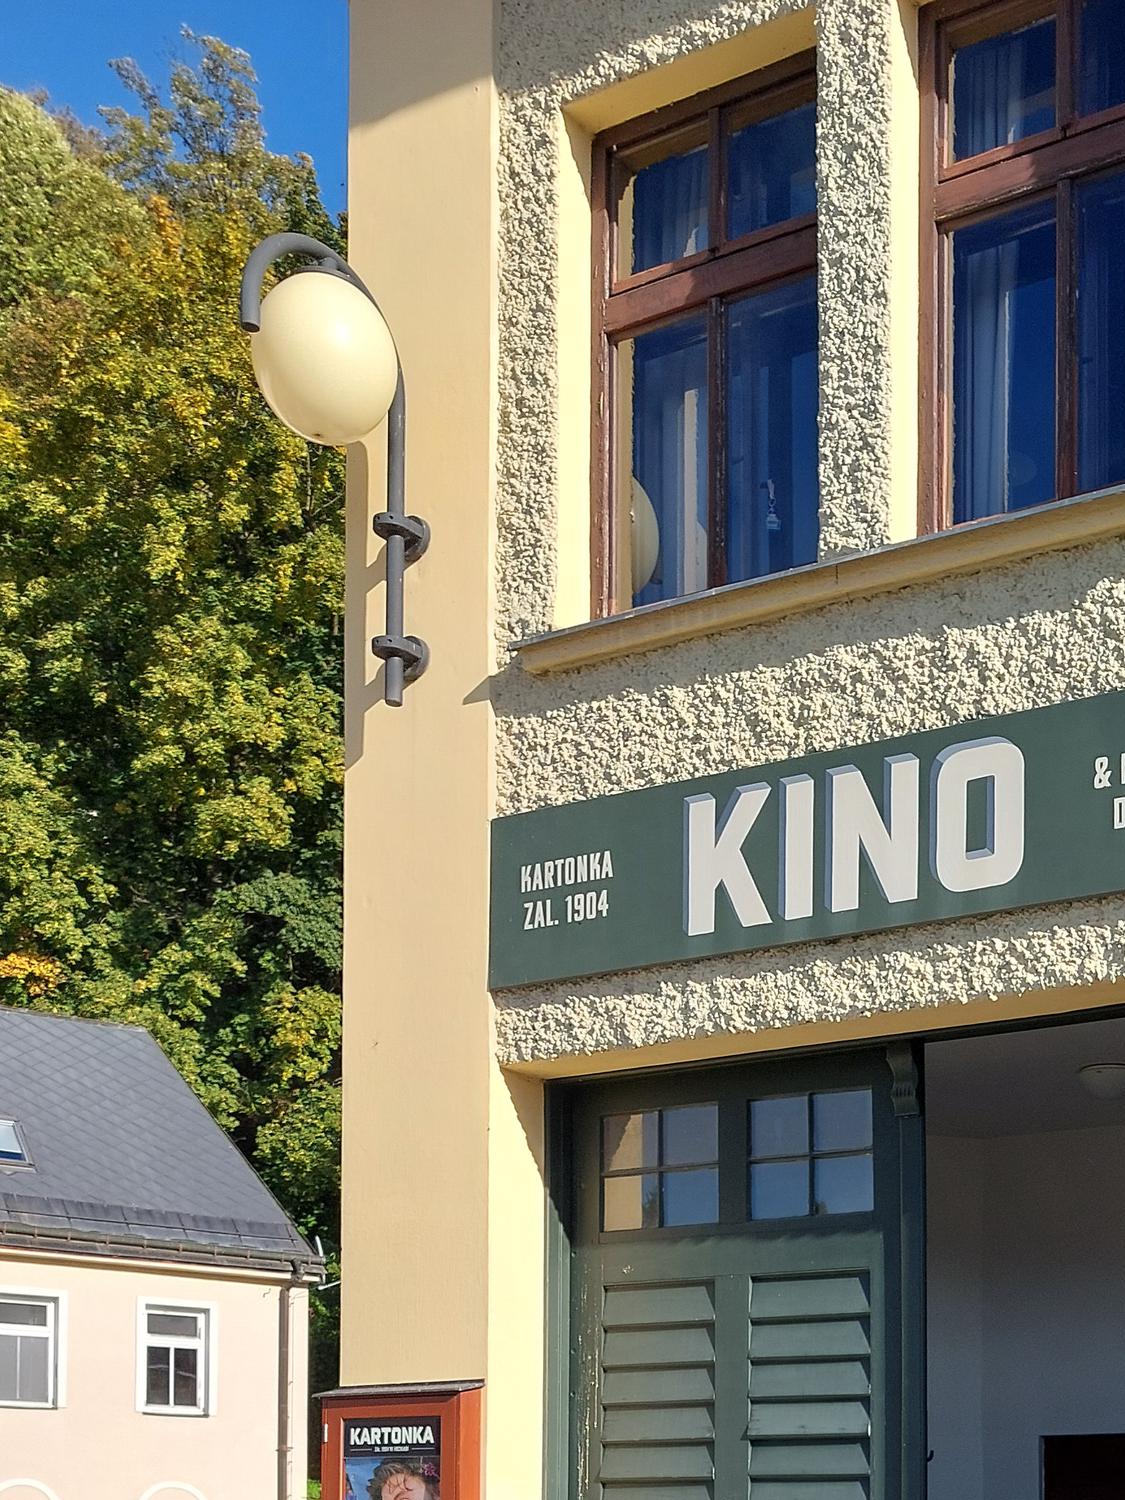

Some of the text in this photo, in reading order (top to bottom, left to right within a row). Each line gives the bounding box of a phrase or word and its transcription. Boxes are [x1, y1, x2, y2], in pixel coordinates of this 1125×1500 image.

[1093, 756, 1112, 789] &
[683, 735, 1026, 937] KINO
[520, 850, 614, 893] KARTONKA
[522, 889, 610, 932] ZAL. 1904
[350, 1425, 435, 1445] KARTONKA
